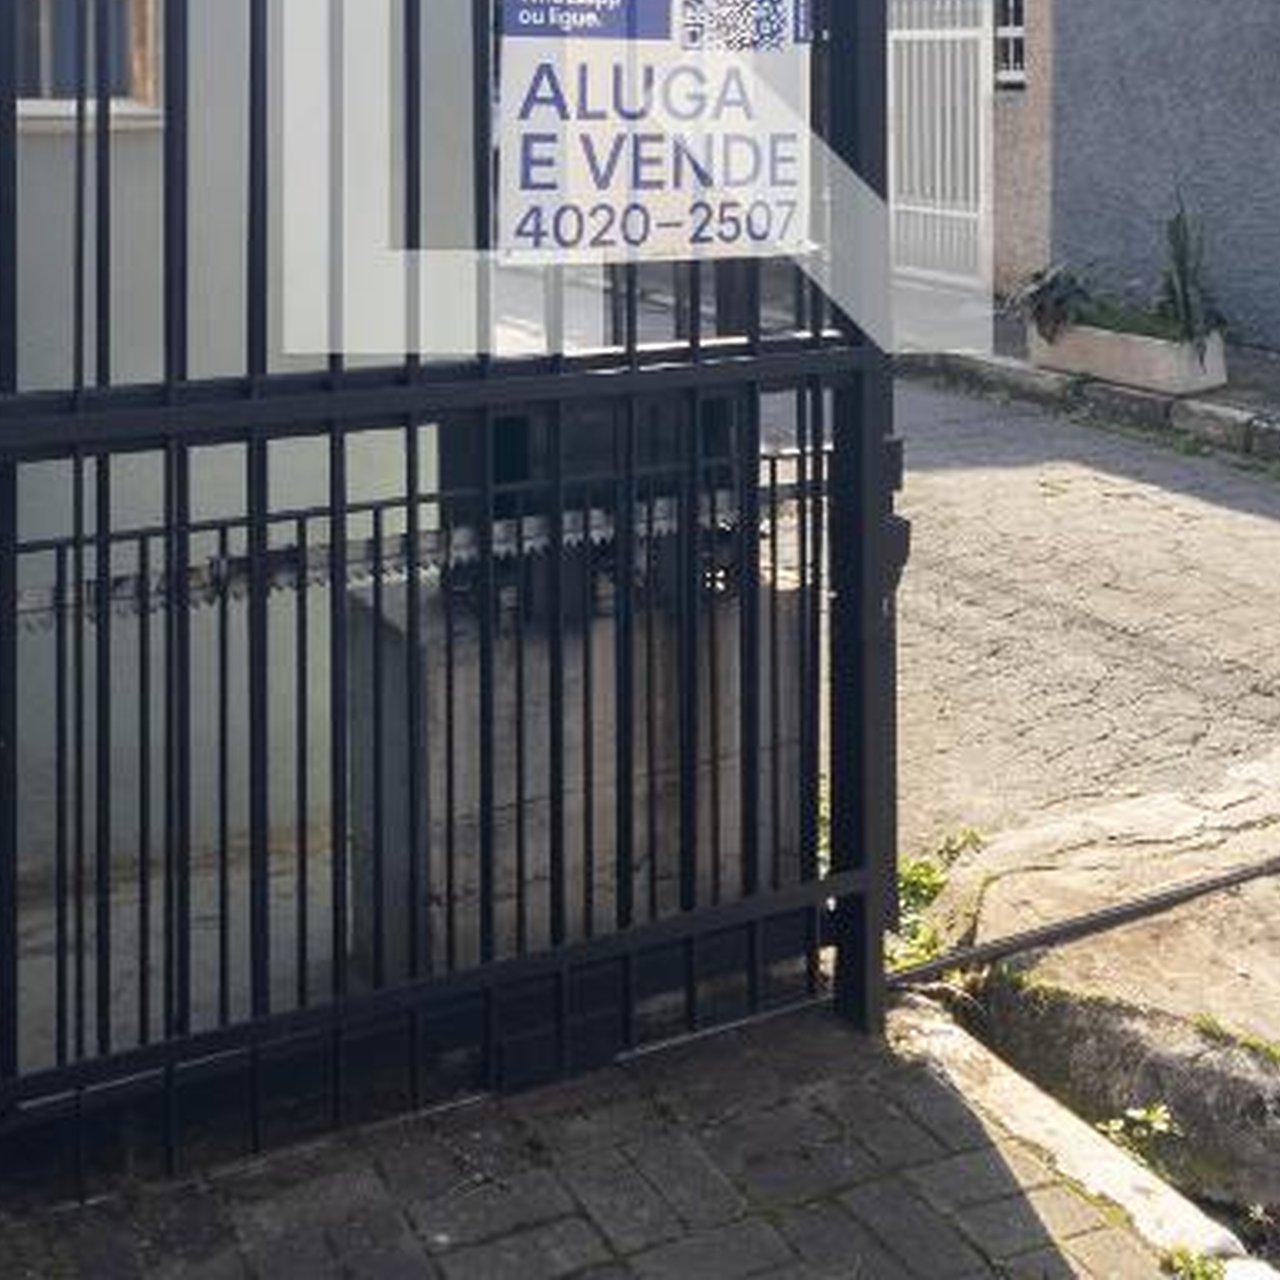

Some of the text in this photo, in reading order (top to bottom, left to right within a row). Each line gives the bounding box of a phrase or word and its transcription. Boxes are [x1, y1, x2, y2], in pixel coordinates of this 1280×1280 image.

[520, 9, 544, 24] ou
[517, 63, 753, 121] ALUGA
[520, 133, 798, 191] E VENDE
